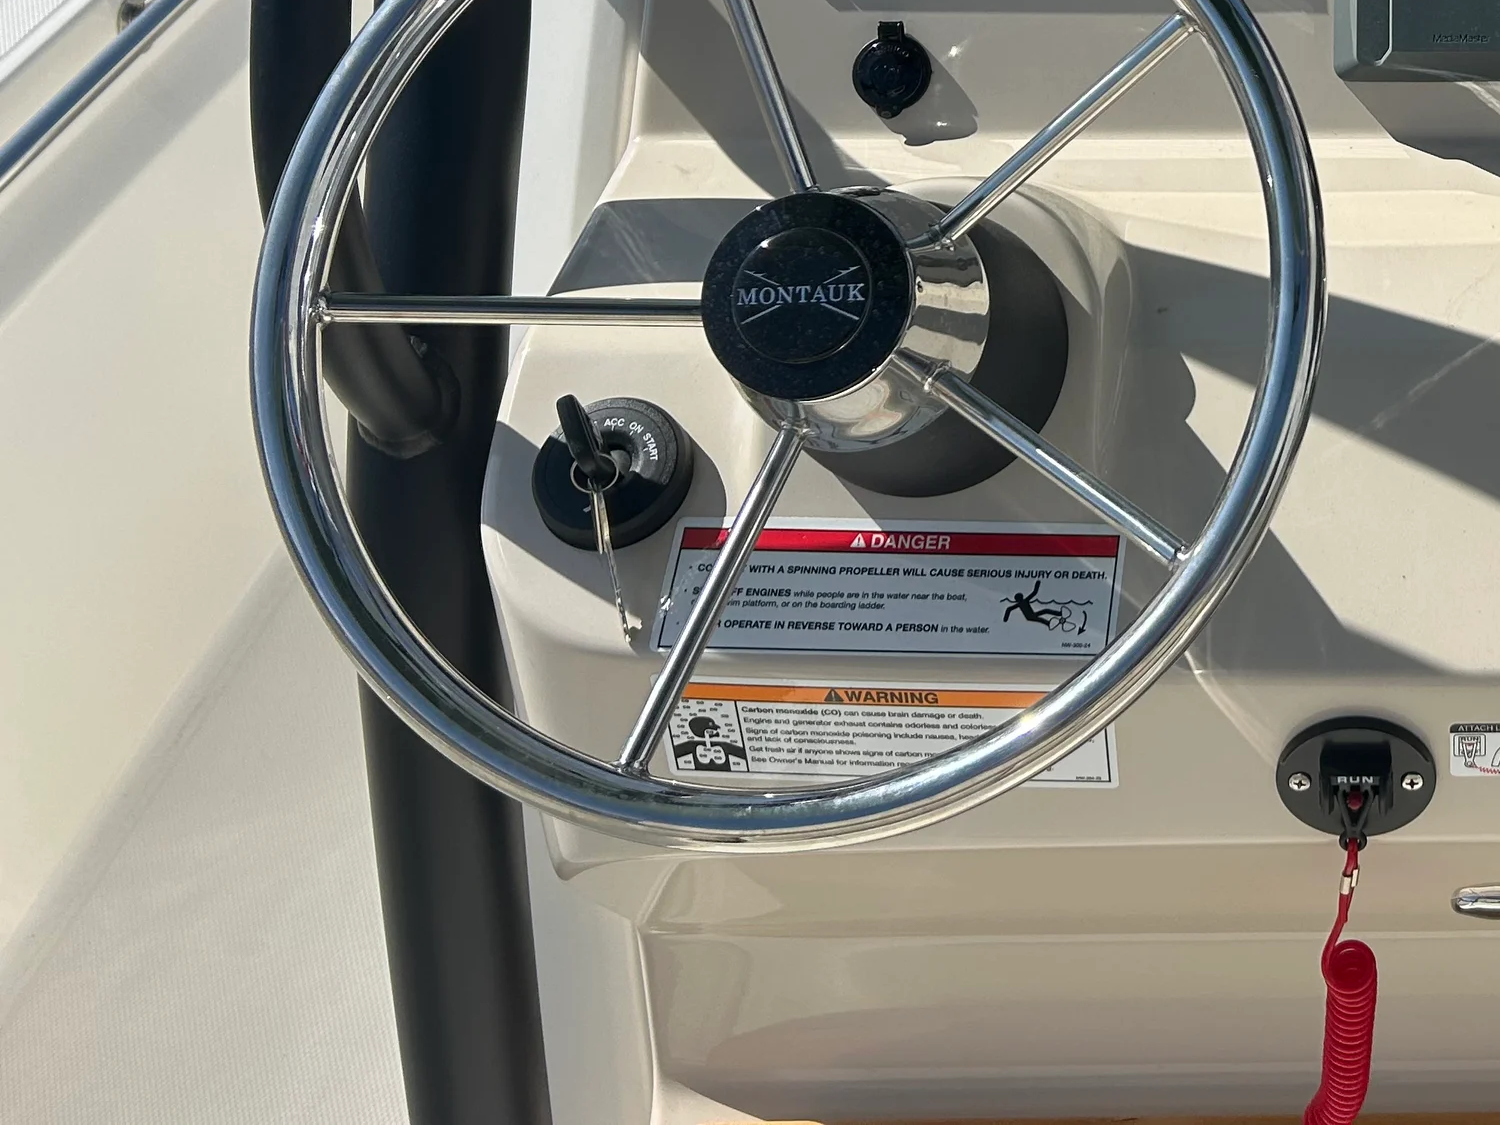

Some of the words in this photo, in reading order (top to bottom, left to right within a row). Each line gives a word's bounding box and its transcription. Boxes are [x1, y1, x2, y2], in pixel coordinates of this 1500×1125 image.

[736, 282, 866, 306] MONTAUK
[603, 418, 626, 427] ACC
[629, 421, 644, 434] ON
[642, 432, 659, 462] START
[870, 534, 951, 550] DANGER
[749, 565, 775, 574] WITH
[777, 565, 785, 574] A
[787, 565, 837, 575] SPINNING
[839, 566, 900, 576] PROPELLER
[903, 568, 927, 577] WILL
[929, 568, 965, 577] CAUSE
[967, 569, 1012, 578] SERIOUS
[1014, 570, 1052, 579] INJURY
[1053, 570, 1070, 580] OR
[1072, 570, 1108, 580] DEATH.
[746, 588, 791, 597] ENGINES
[793, 589, 815, 598] while
[816, 591, 845, 599] people
[871, 591, 884, 599] the
[887, 592, 909, 600] water
[931, 592, 944, 601] the
[946, 592, 968, 602] boat,
[742, 599, 779, 608] platform,
[819, 601, 856, 610] boarding
[858, 601, 885, 610] ladder.
[723, 620, 772, 629] OPERATE
[774, 620, 785, 630] IN
[787, 621, 836, 631] REVERSE
[838, 622, 883, 632] TOWARD
[885, 623, 893, 632] A
[895, 623, 939, 633] PERSON
[940, 625, 949, 633] in
[950, 624, 964, 633] the
[966, 625, 990, 634] water.
[844, 691, 939, 704] WARNING
[741, 706, 774, 714] Carbon
[821, 708, 842, 717] (CO)
[911, 711, 945, 720] damage
[743, 717, 772, 725] Engine
[792, 719, 832, 727] generator
[1458, 724, 1493, 732] ATTACH
[745, 727, 769, 735] Signs
[852, 731, 892, 740] poisoning
[849, 759, 895, 767] information
[1337, 775, 1374, 784] RUN
